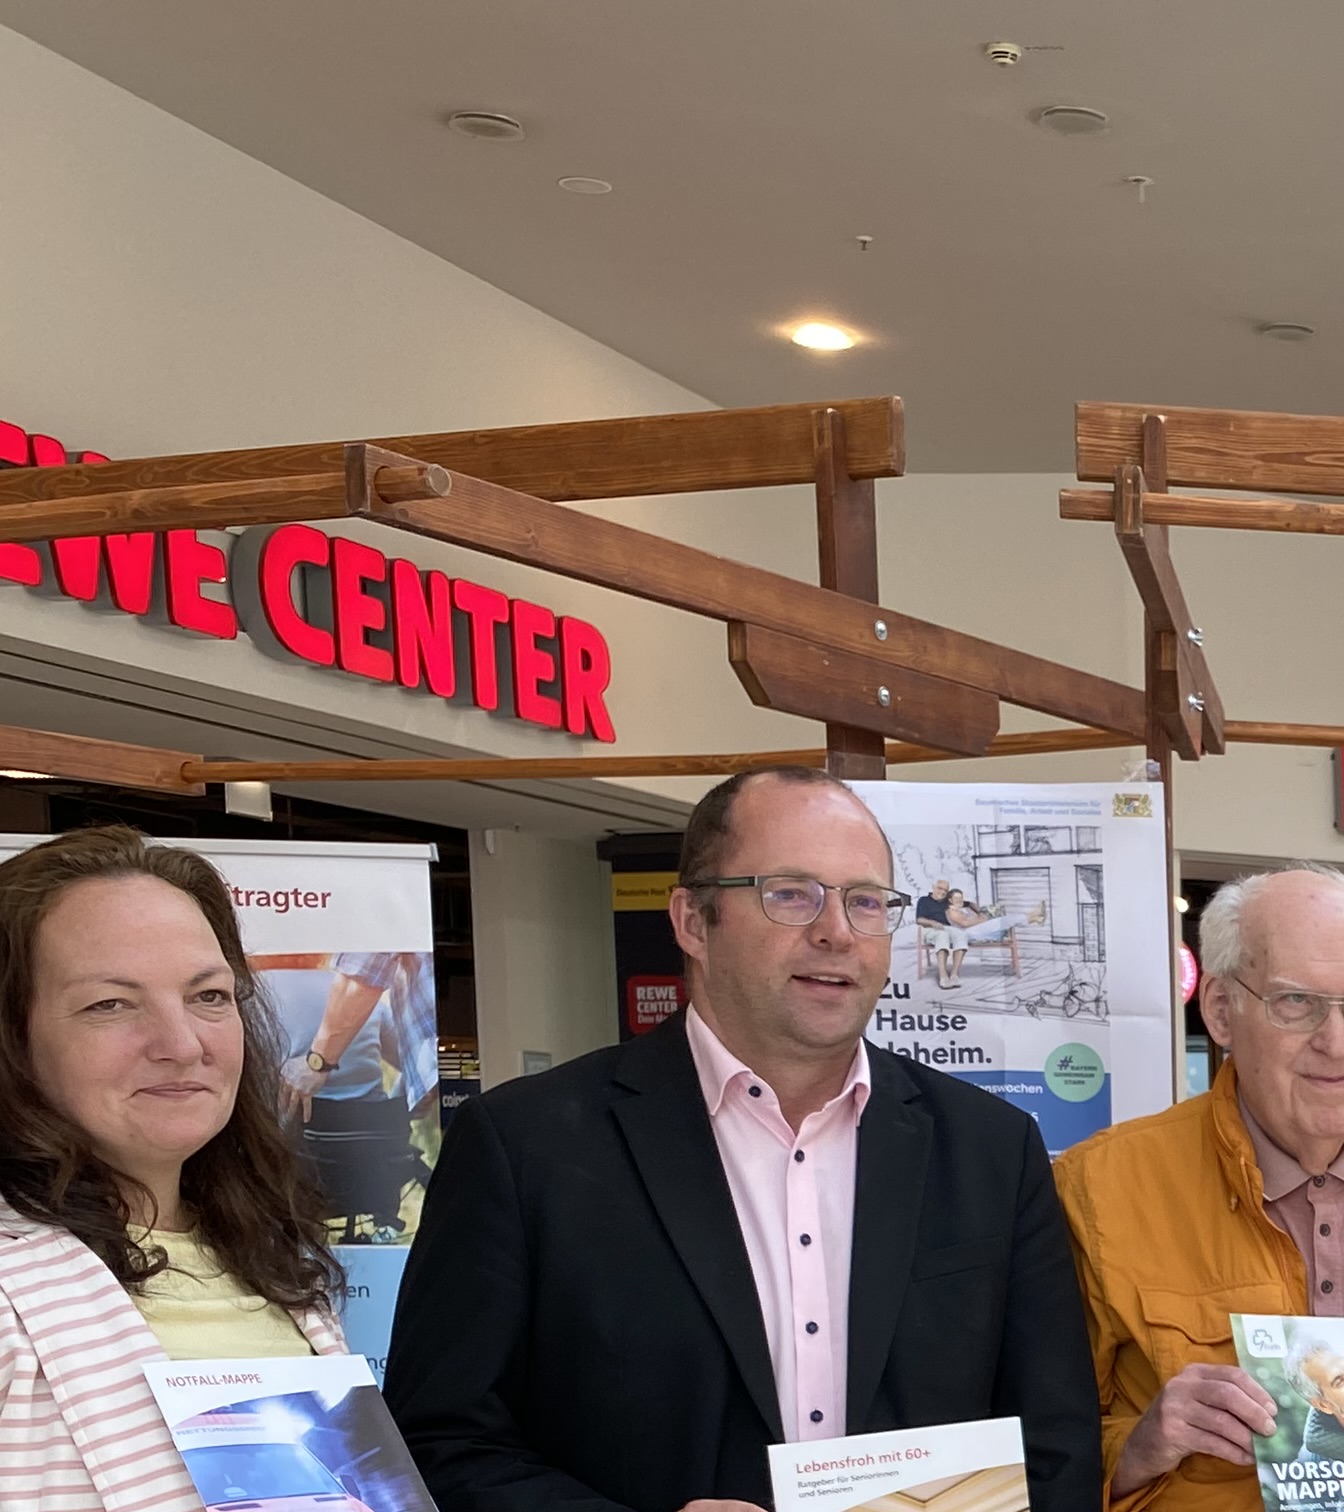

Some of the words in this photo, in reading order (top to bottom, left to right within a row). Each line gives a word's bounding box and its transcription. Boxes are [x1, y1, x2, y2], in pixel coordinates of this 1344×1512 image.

[259, 523, 616, 743] CENTER
[226, 883, 332, 913] tragter
[636, 986, 678, 1001] REWE
[637, 1001, 678, 1014] CENTER
[876, 1009, 968, 1031] Hause
[165, 1373, 263, 1388] NOTFALL-MAPPE
[796, 1453, 875, 1474] Lebensfroh
[878, 1450, 902, 1464] mit
[905, 1447, 932, 1460] 60+
